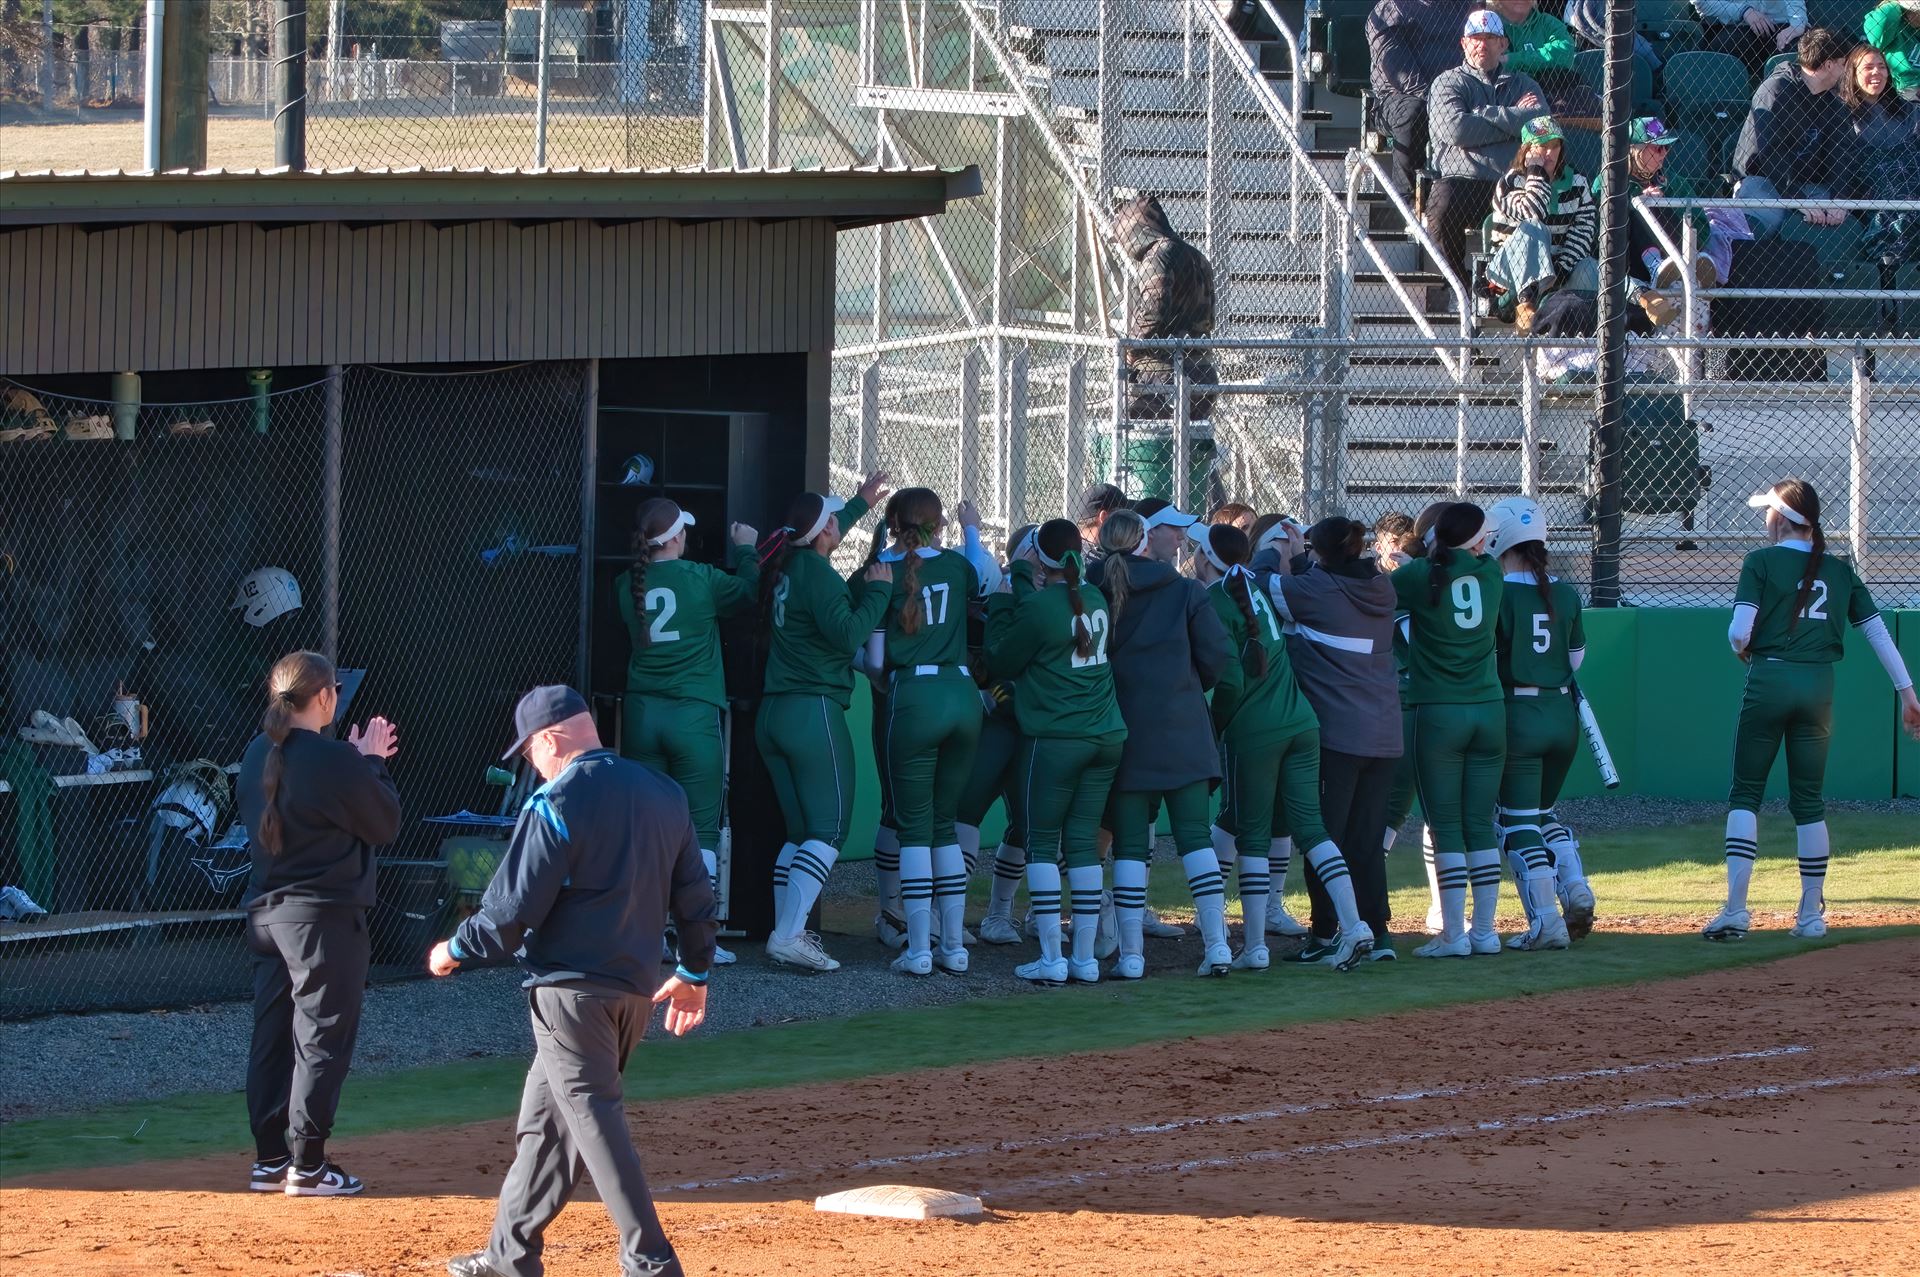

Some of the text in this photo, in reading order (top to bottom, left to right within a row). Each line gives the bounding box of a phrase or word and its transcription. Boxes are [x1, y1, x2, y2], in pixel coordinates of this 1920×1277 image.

[645, 587, 680, 642] 2
[922, 582, 949, 625] 17
[1451, 575, 1482, 629] 9
[1071, 609, 1108, 668] 22
[1533, 613, 1551, 653] 5
